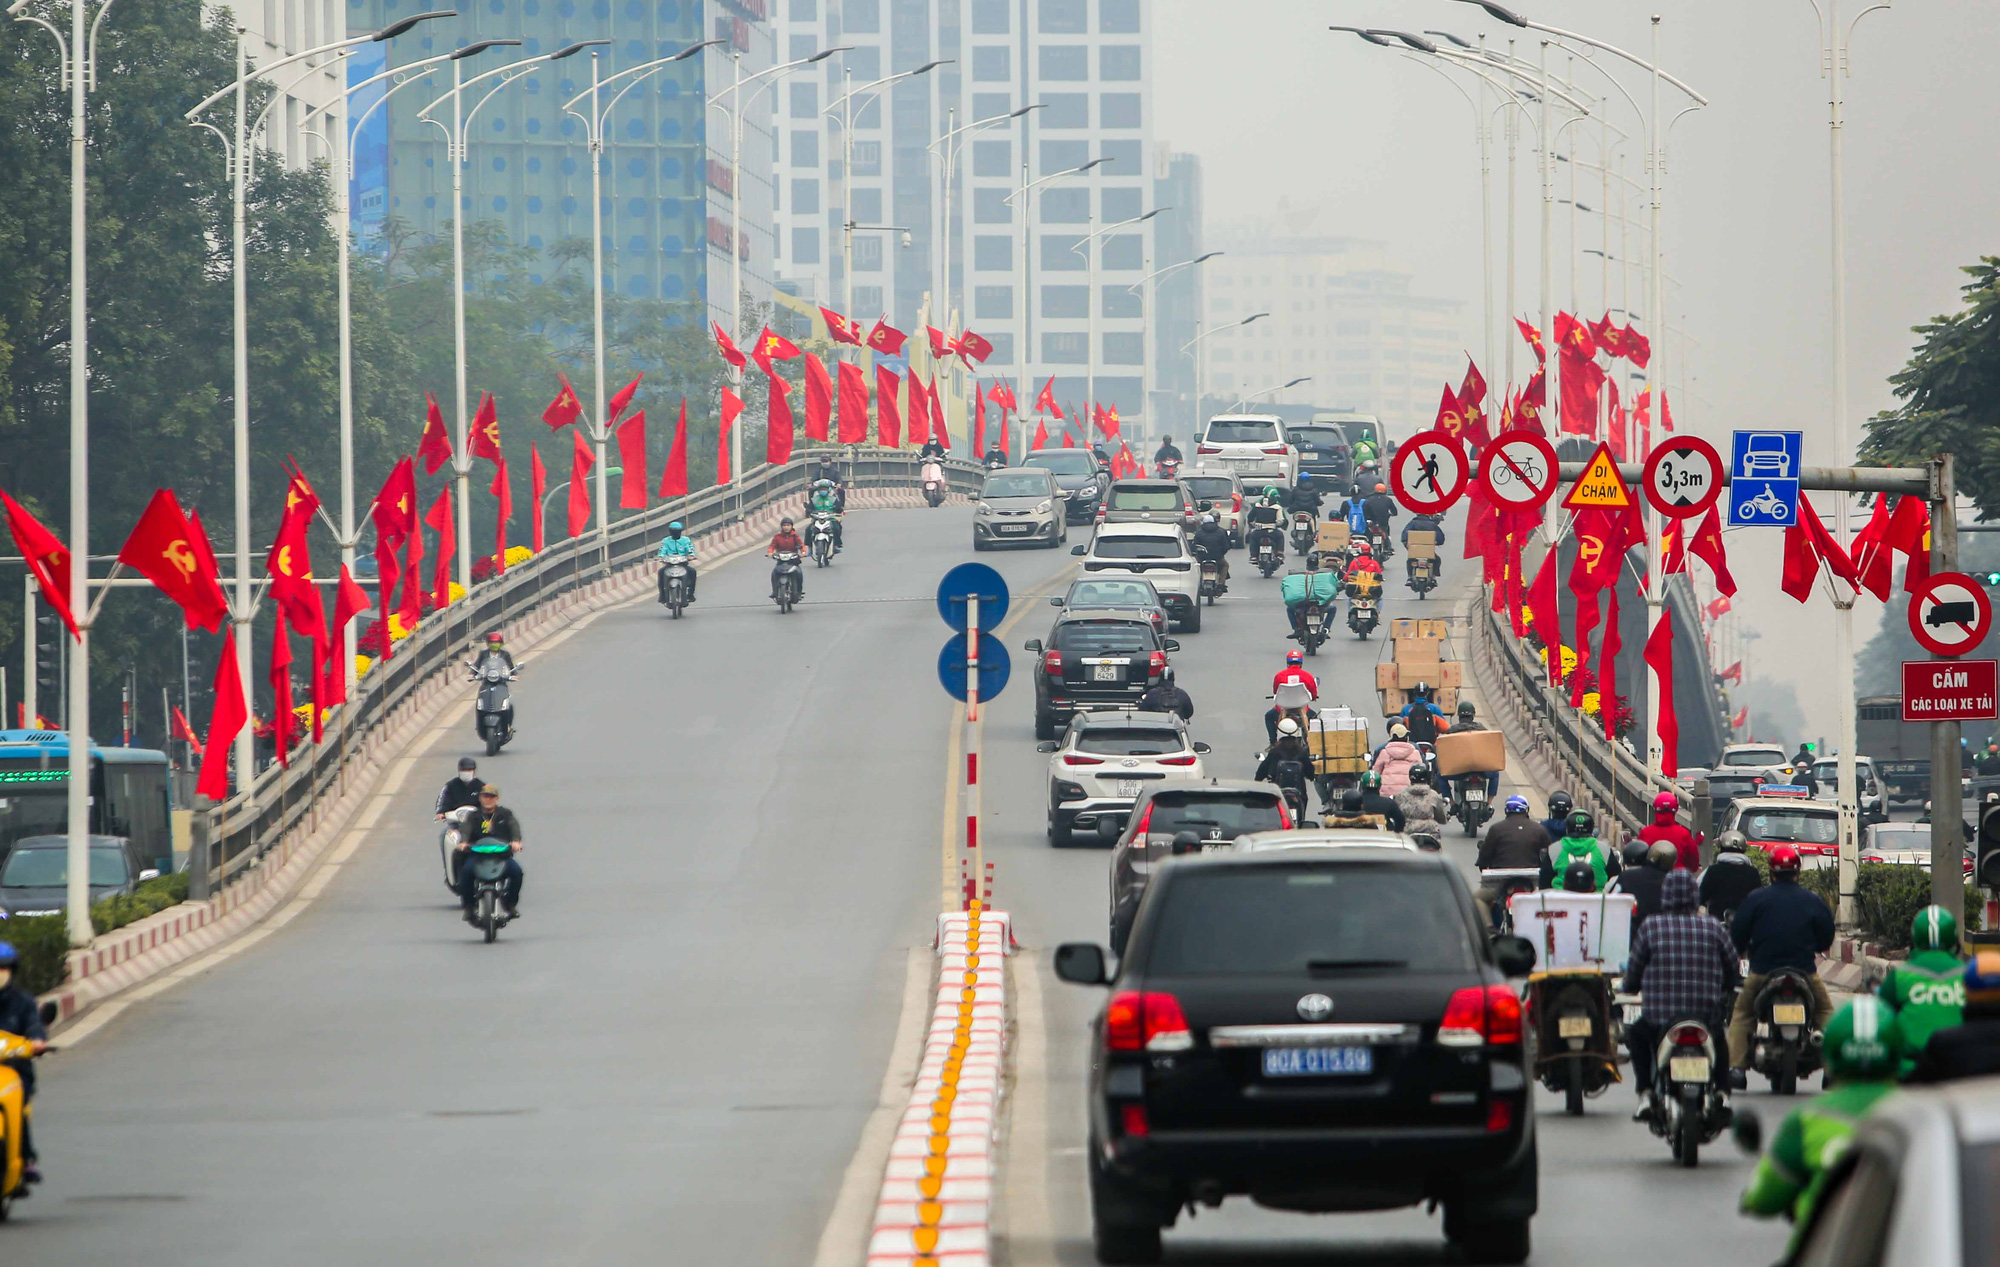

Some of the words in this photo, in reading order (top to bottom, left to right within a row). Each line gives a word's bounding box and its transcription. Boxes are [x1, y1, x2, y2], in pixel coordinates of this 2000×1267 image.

[1595, 465, 1607, 477] ĐI
[1661, 461, 1703, 494] 3,3m
[1582, 482, 1617, 501] CHẬM
[1932, 667, 1968, 689] CẤM
[1911, 697, 1932, 711] CÁC
[1934, 698, 1957, 713] LOẠI
[1960, 697, 1973, 709] XE
[1976, 693, 1992, 709] TẢI
